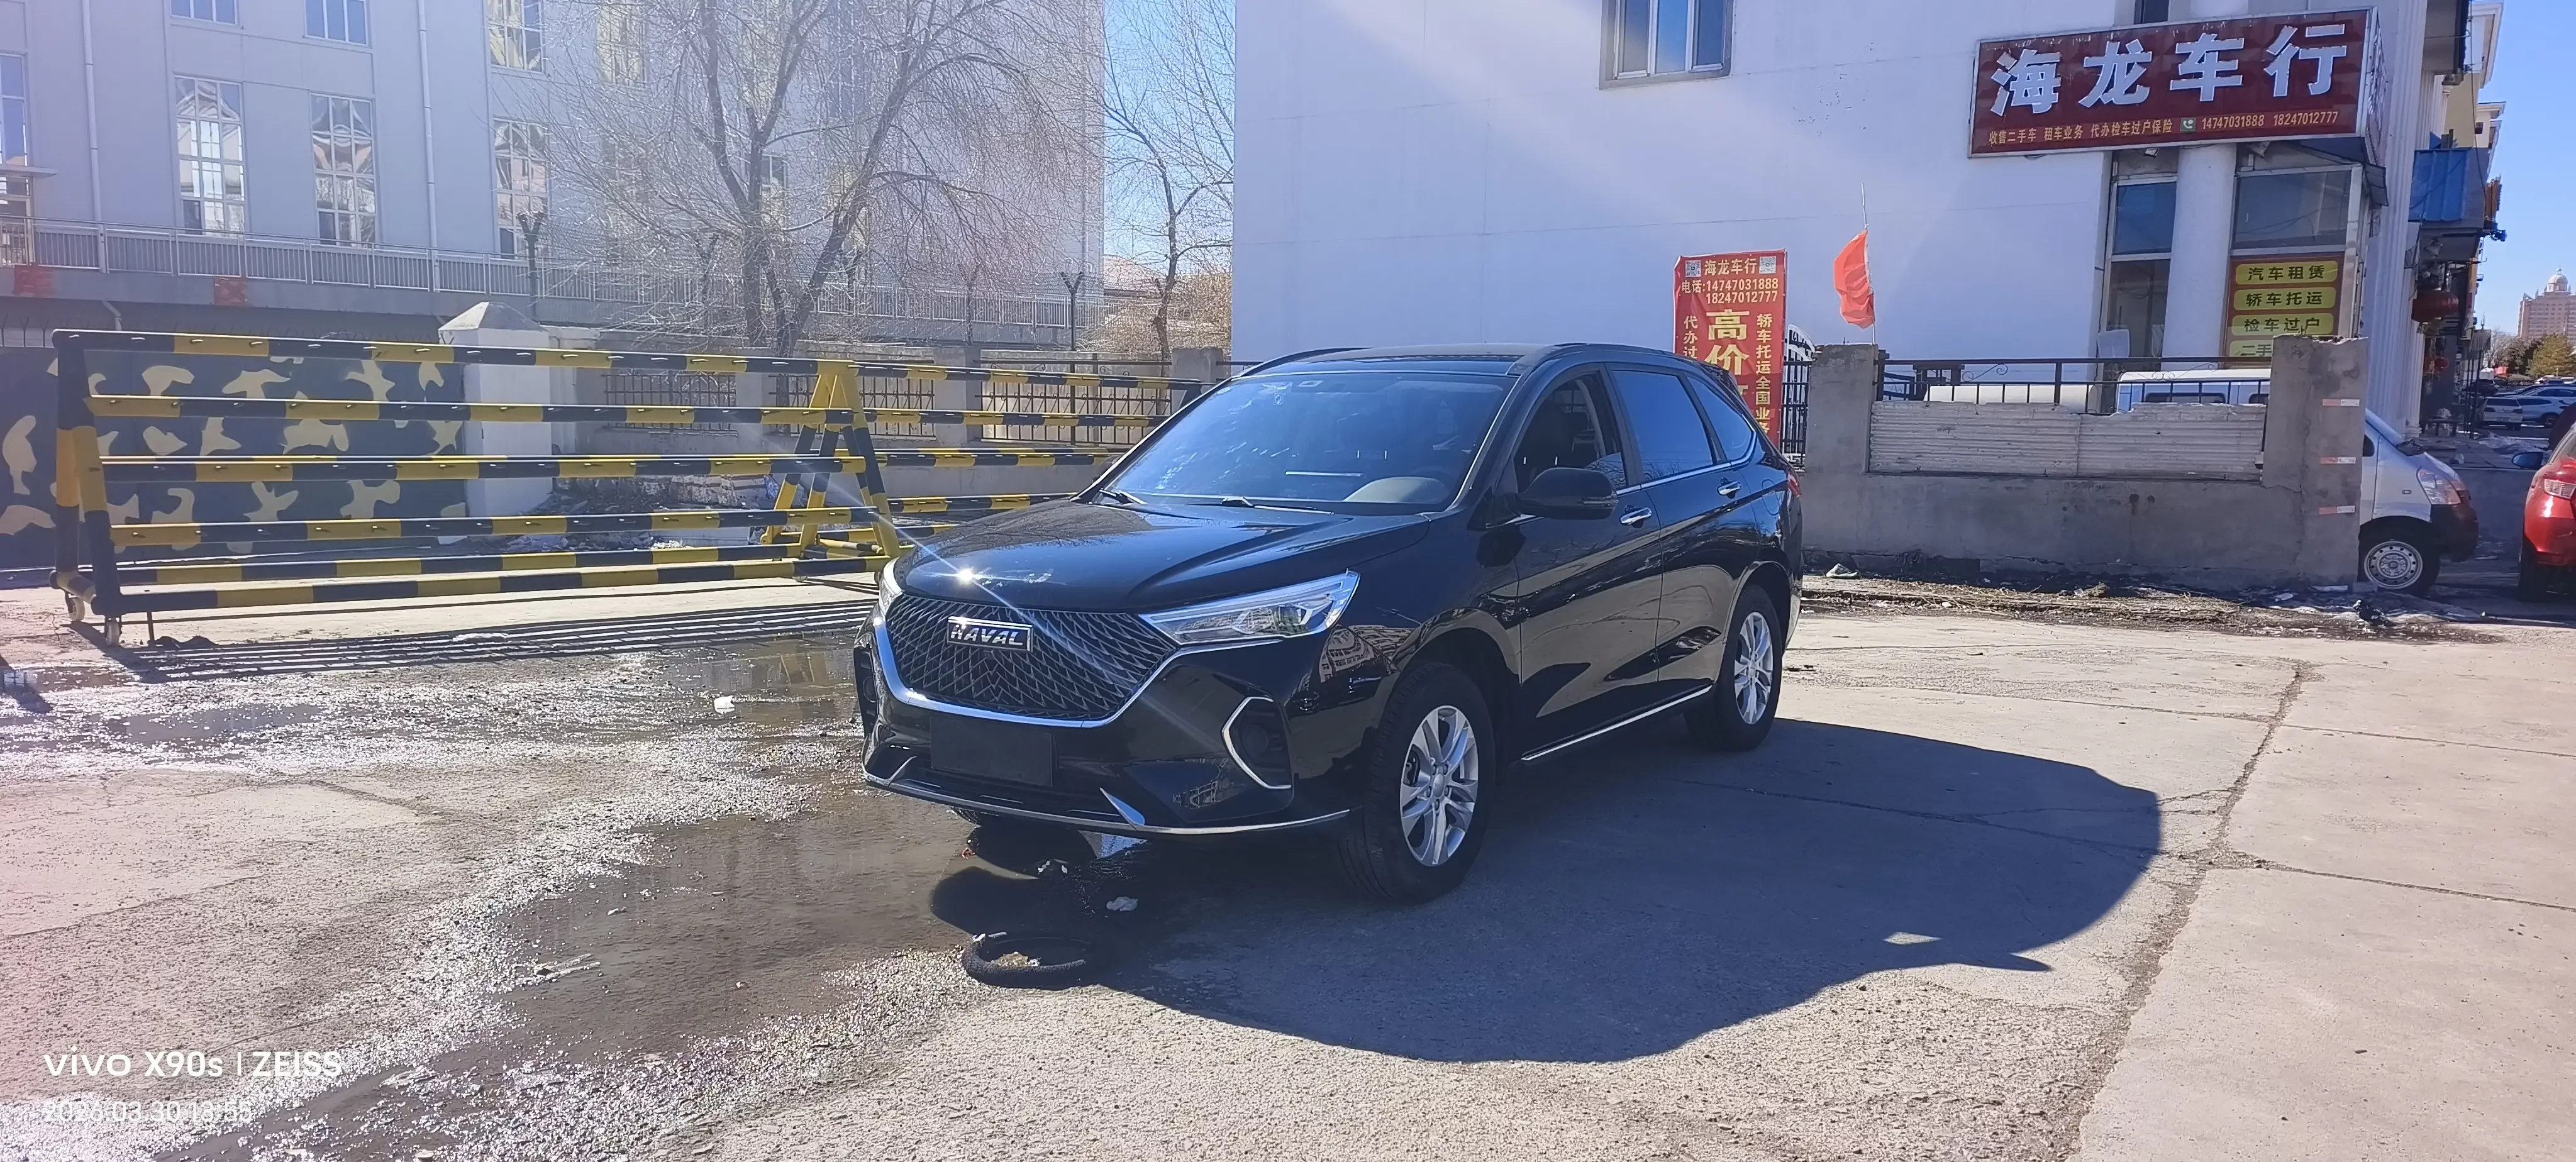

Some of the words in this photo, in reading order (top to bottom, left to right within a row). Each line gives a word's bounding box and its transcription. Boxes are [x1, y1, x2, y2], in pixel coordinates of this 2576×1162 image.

[1990, 23, 2347, 116] 海龙车行
[1989, 128, 2038, 145] 收售二手车
[2044, 124, 2084, 141] 租车业务
[2090, 118, 2173, 138] 代办检车过户保险
[2202, 114, 2265, 130] 14747031888
[2273, 111, 2338, 126] 18247012777
[1704, 257, 1757, 277] 海龙车行
[2248, 265, 2325, 281] 汽车租赁
[1681, 277, 1779, 294] 电话:14747031888
[1706, 290, 1779, 304] 18247012777
[2246, 291, 2323, 307] 轿车托运
[2244, 317, 2320, 333] 检车过户
[1704, 309, 1750, 396] 高价
[950, 624, 1023, 646] HAVAL
